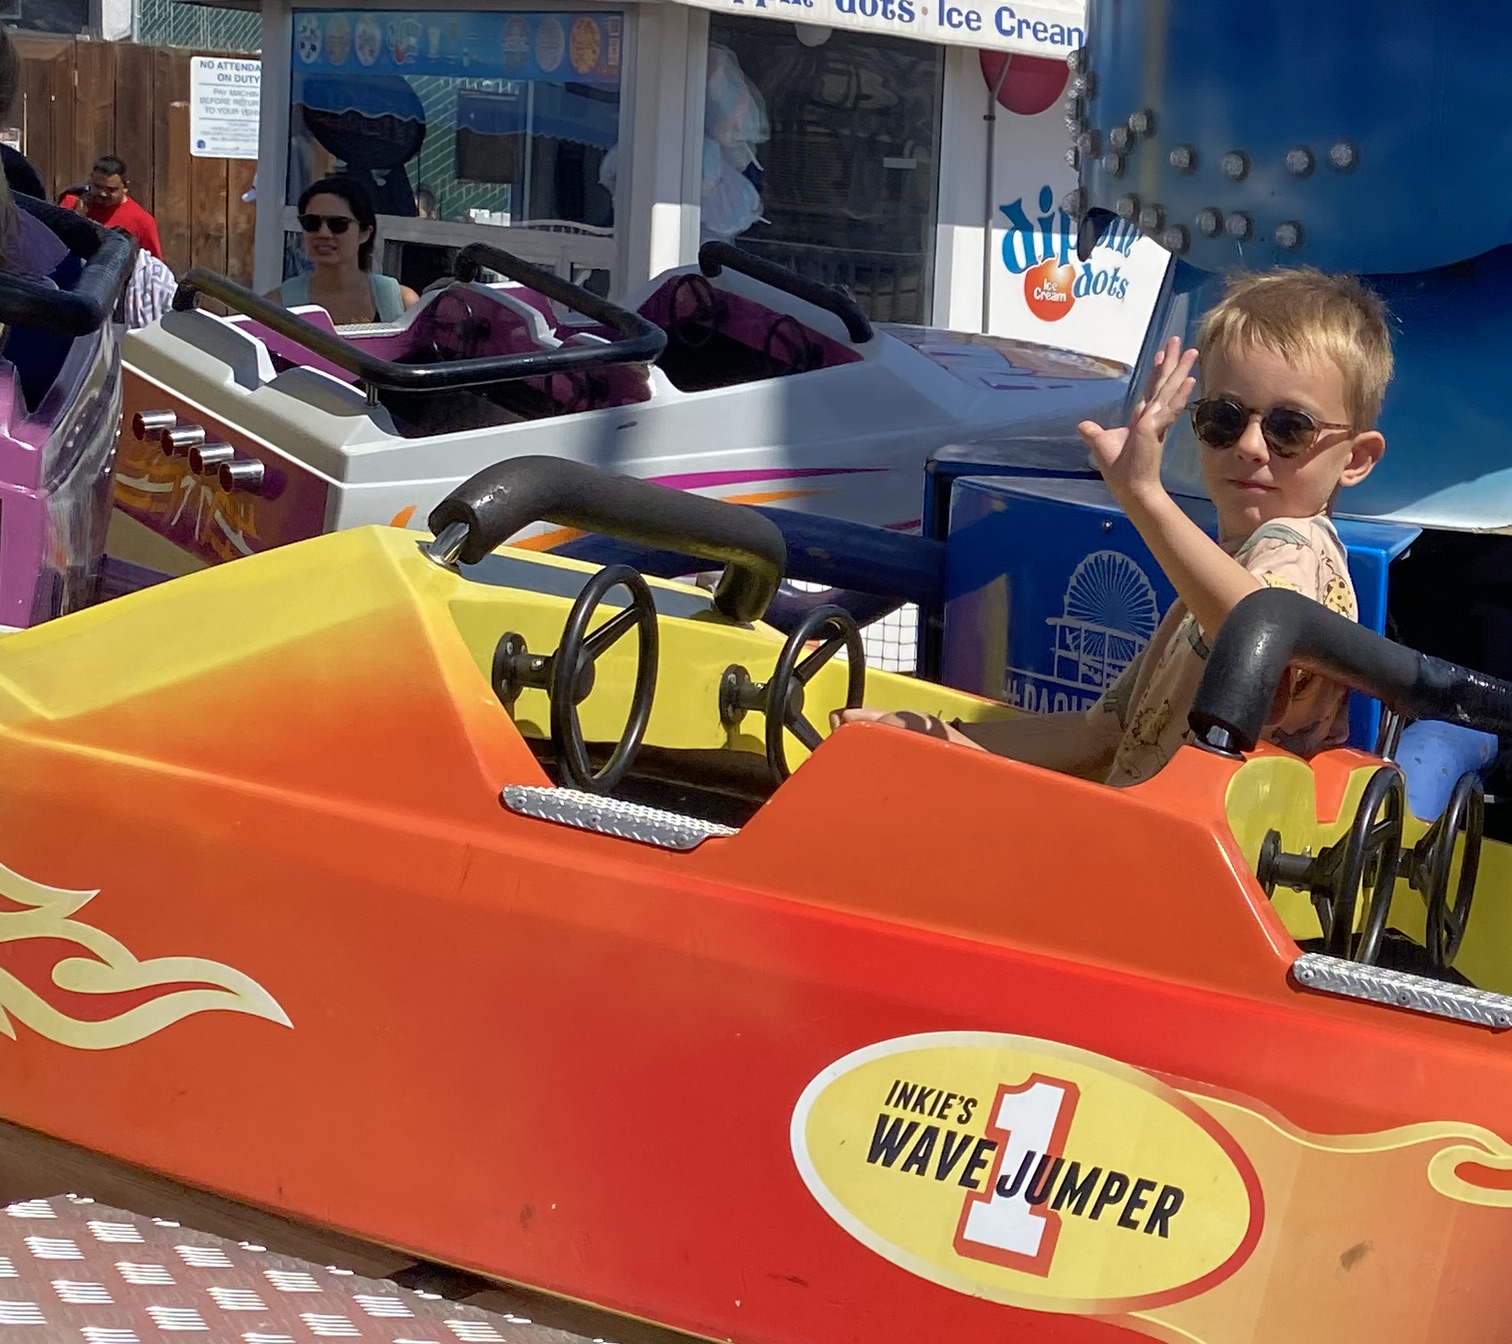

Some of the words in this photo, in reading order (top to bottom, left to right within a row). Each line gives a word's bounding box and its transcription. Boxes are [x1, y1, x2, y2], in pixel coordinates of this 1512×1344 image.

[199, 60, 215, 70] NO
[217, 72, 232, 82] ON
[234, 74, 260, 84] DUTY
[1033, 287, 1067, 303] Cream
[1043, 277, 1059, 292] Ice
[1073, 262, 1130, 301] dots
[883, 1079, 978, 1125] INKIE'S
[866, 1113, 998, 1191] WAVE
[994, 1150, 1186, 1239] JUMPER
[957, 1075, 1074, 1270] 1
